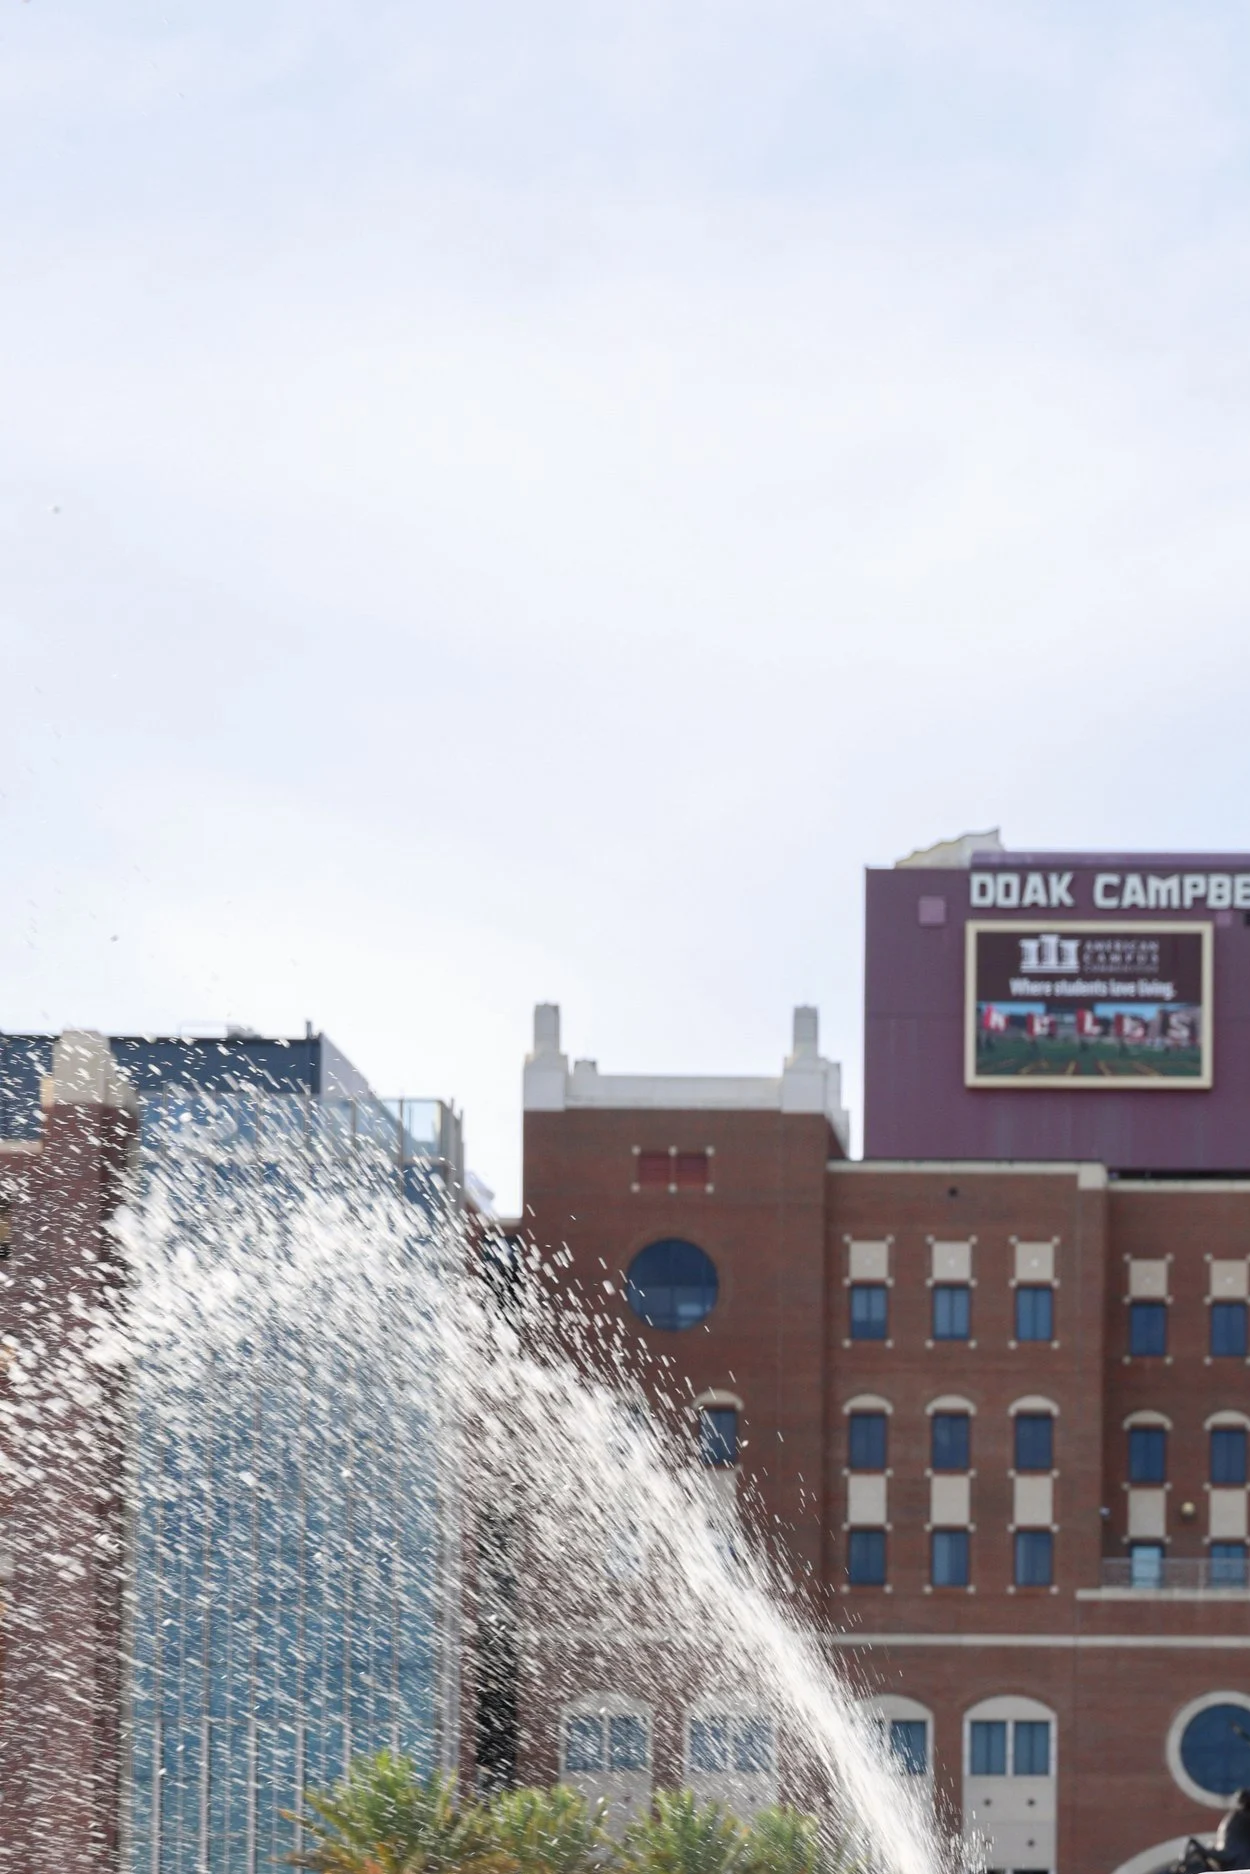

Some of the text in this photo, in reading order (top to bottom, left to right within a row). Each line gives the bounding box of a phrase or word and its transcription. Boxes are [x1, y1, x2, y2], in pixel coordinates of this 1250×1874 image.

[970, 872, 1075, 908] DOAK
[1009, 977, 1051, 996] Where
[1054, 977, 1108, 996] students
